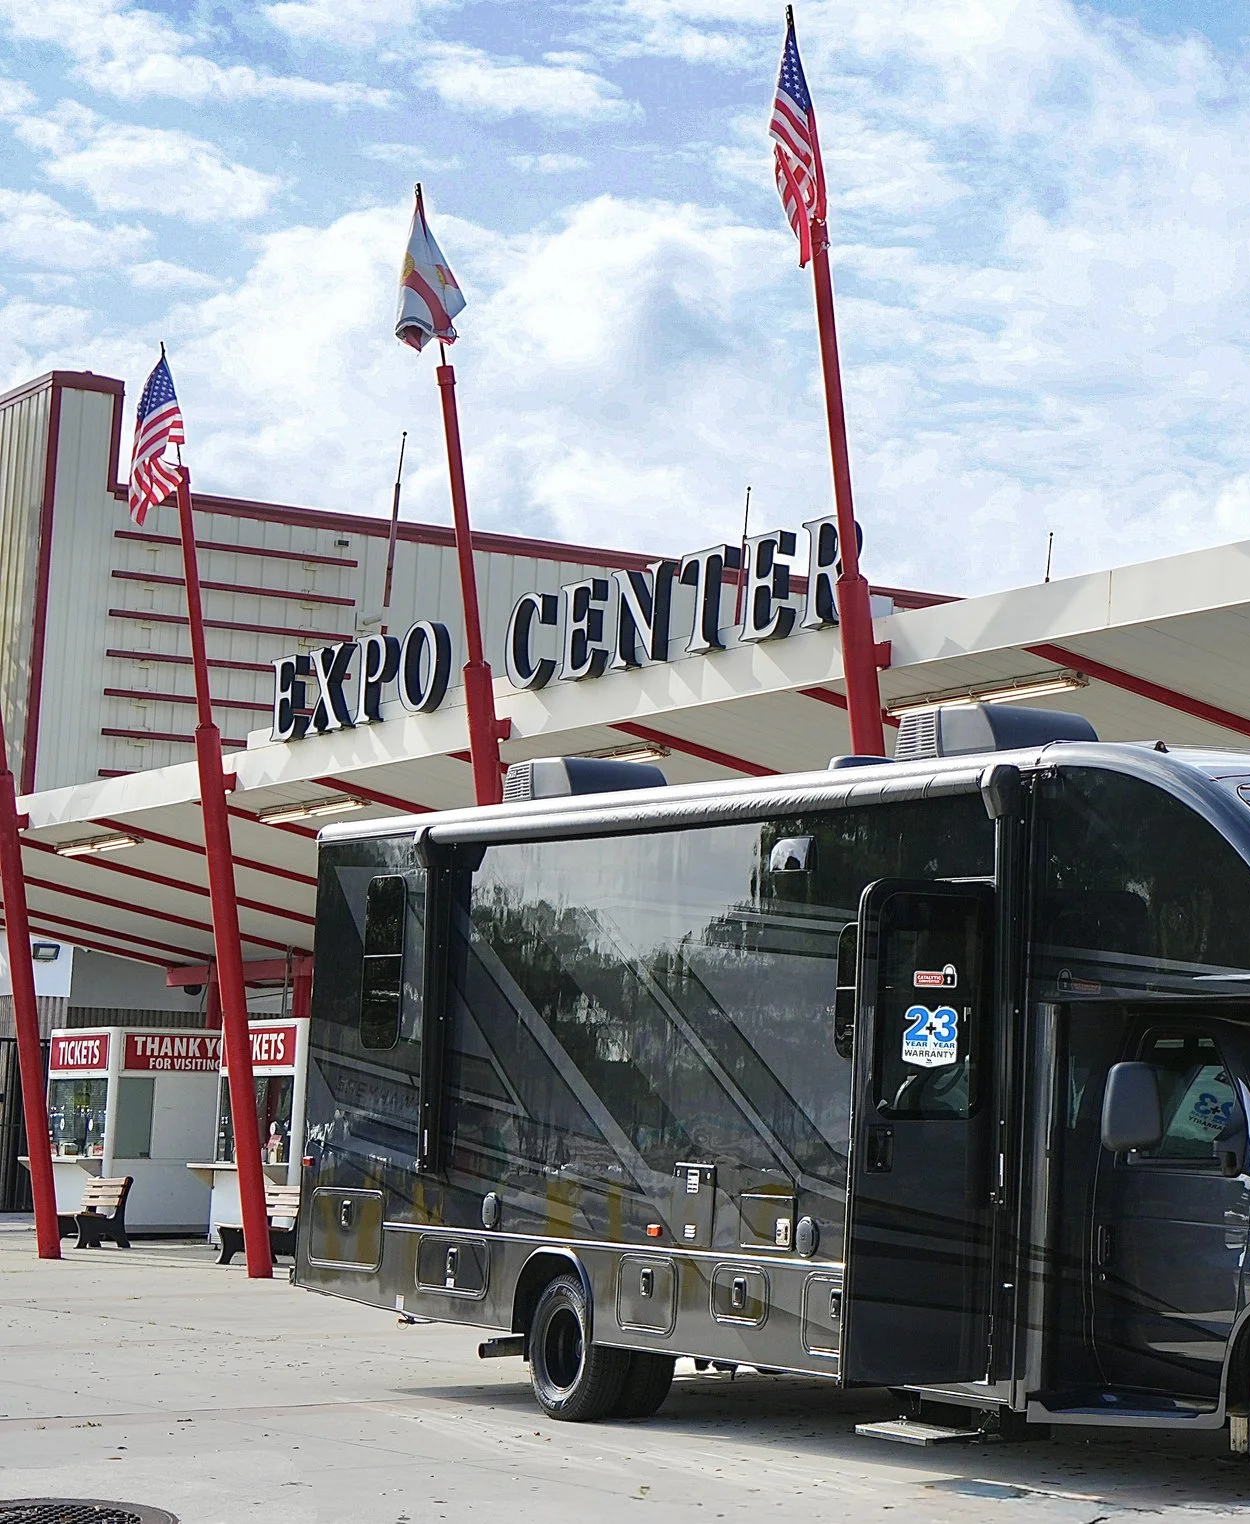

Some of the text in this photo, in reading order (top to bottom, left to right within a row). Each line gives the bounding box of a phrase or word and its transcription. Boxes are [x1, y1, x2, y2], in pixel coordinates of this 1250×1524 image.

[270, 514, 863, 743] EXPO CENTER
[58, 1039, 101, 1066] TICKETS
[135, 1036, 201, 1057] THANK
[249, 1032, 285, 1061] KETS
[904, 1049, 955, 1059] WARRANTY
[933, 1041, 955, 1049] YEAR
[149, 1058, 221, 1071] FOR VISITING
